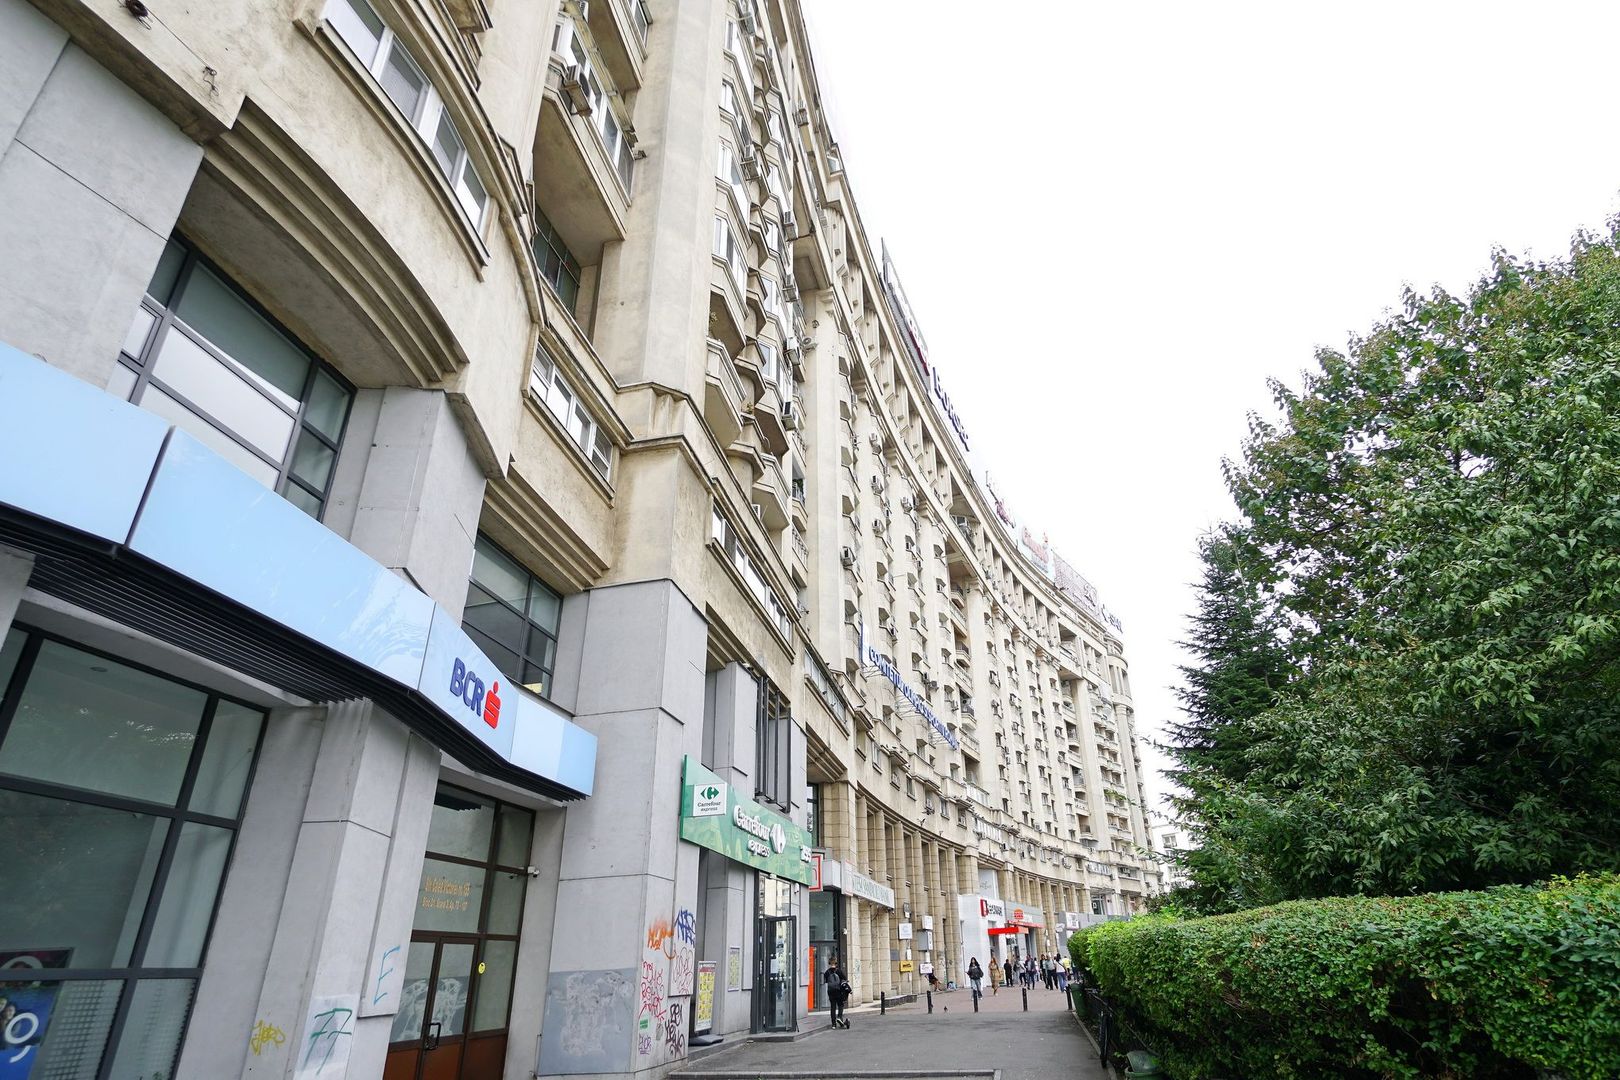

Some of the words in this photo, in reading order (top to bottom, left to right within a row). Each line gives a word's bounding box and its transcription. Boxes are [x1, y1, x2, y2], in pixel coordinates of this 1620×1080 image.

[449, 656, 486, 717] BCR
[733, 805, 770, 841] Carrefour
[747, 839, 770, 858] express
